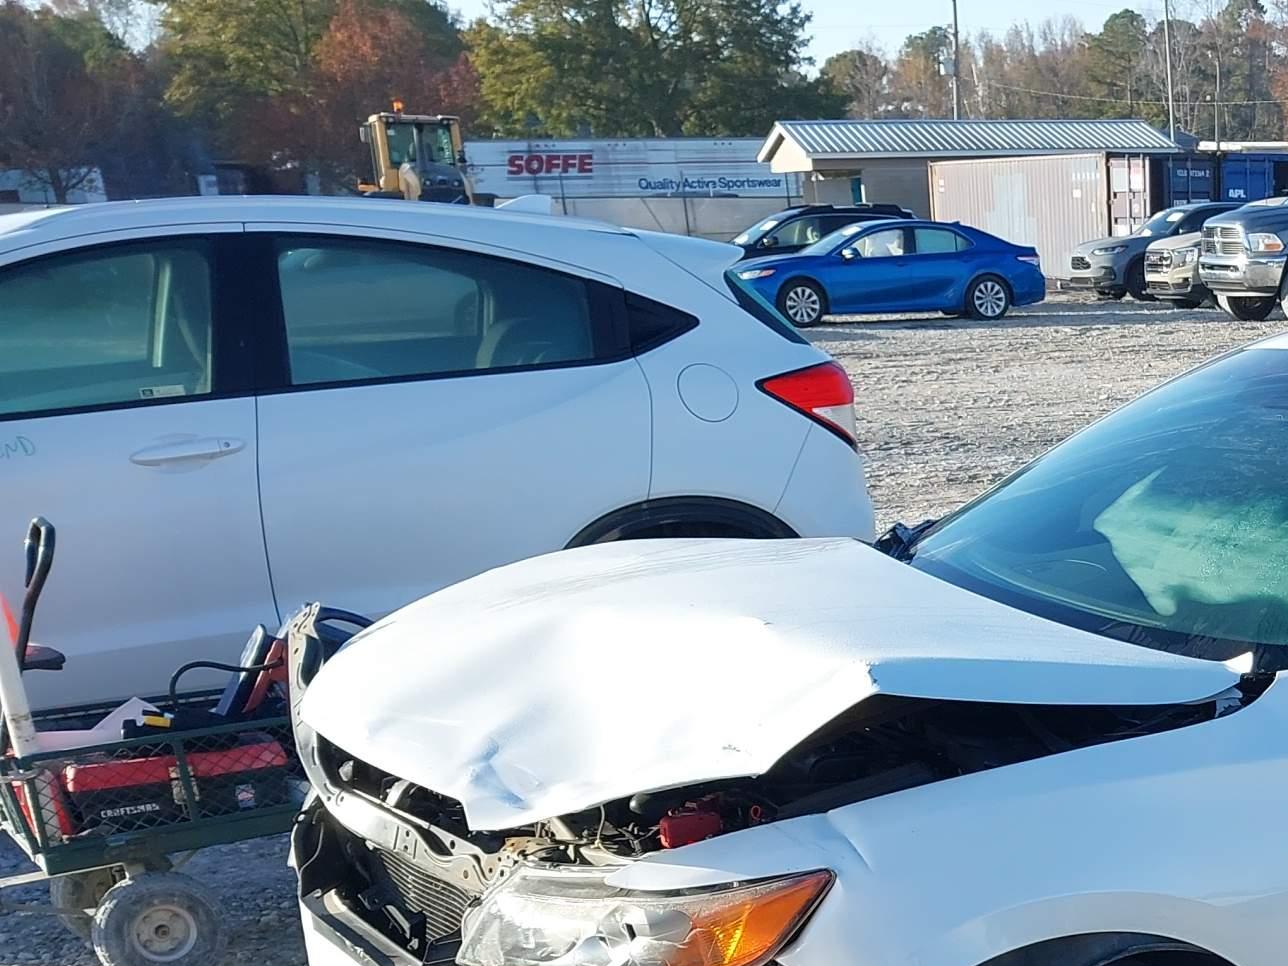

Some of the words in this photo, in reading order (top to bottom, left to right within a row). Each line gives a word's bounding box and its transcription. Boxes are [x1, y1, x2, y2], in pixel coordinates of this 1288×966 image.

[507, 154, 593, 175] SOFFE
[638, 178, 680, 192] Quality
[682, 177, 717, 189] Active
[718, 177, 781, 190] Sportswear
[1229, 189, 1246, 198] APL
